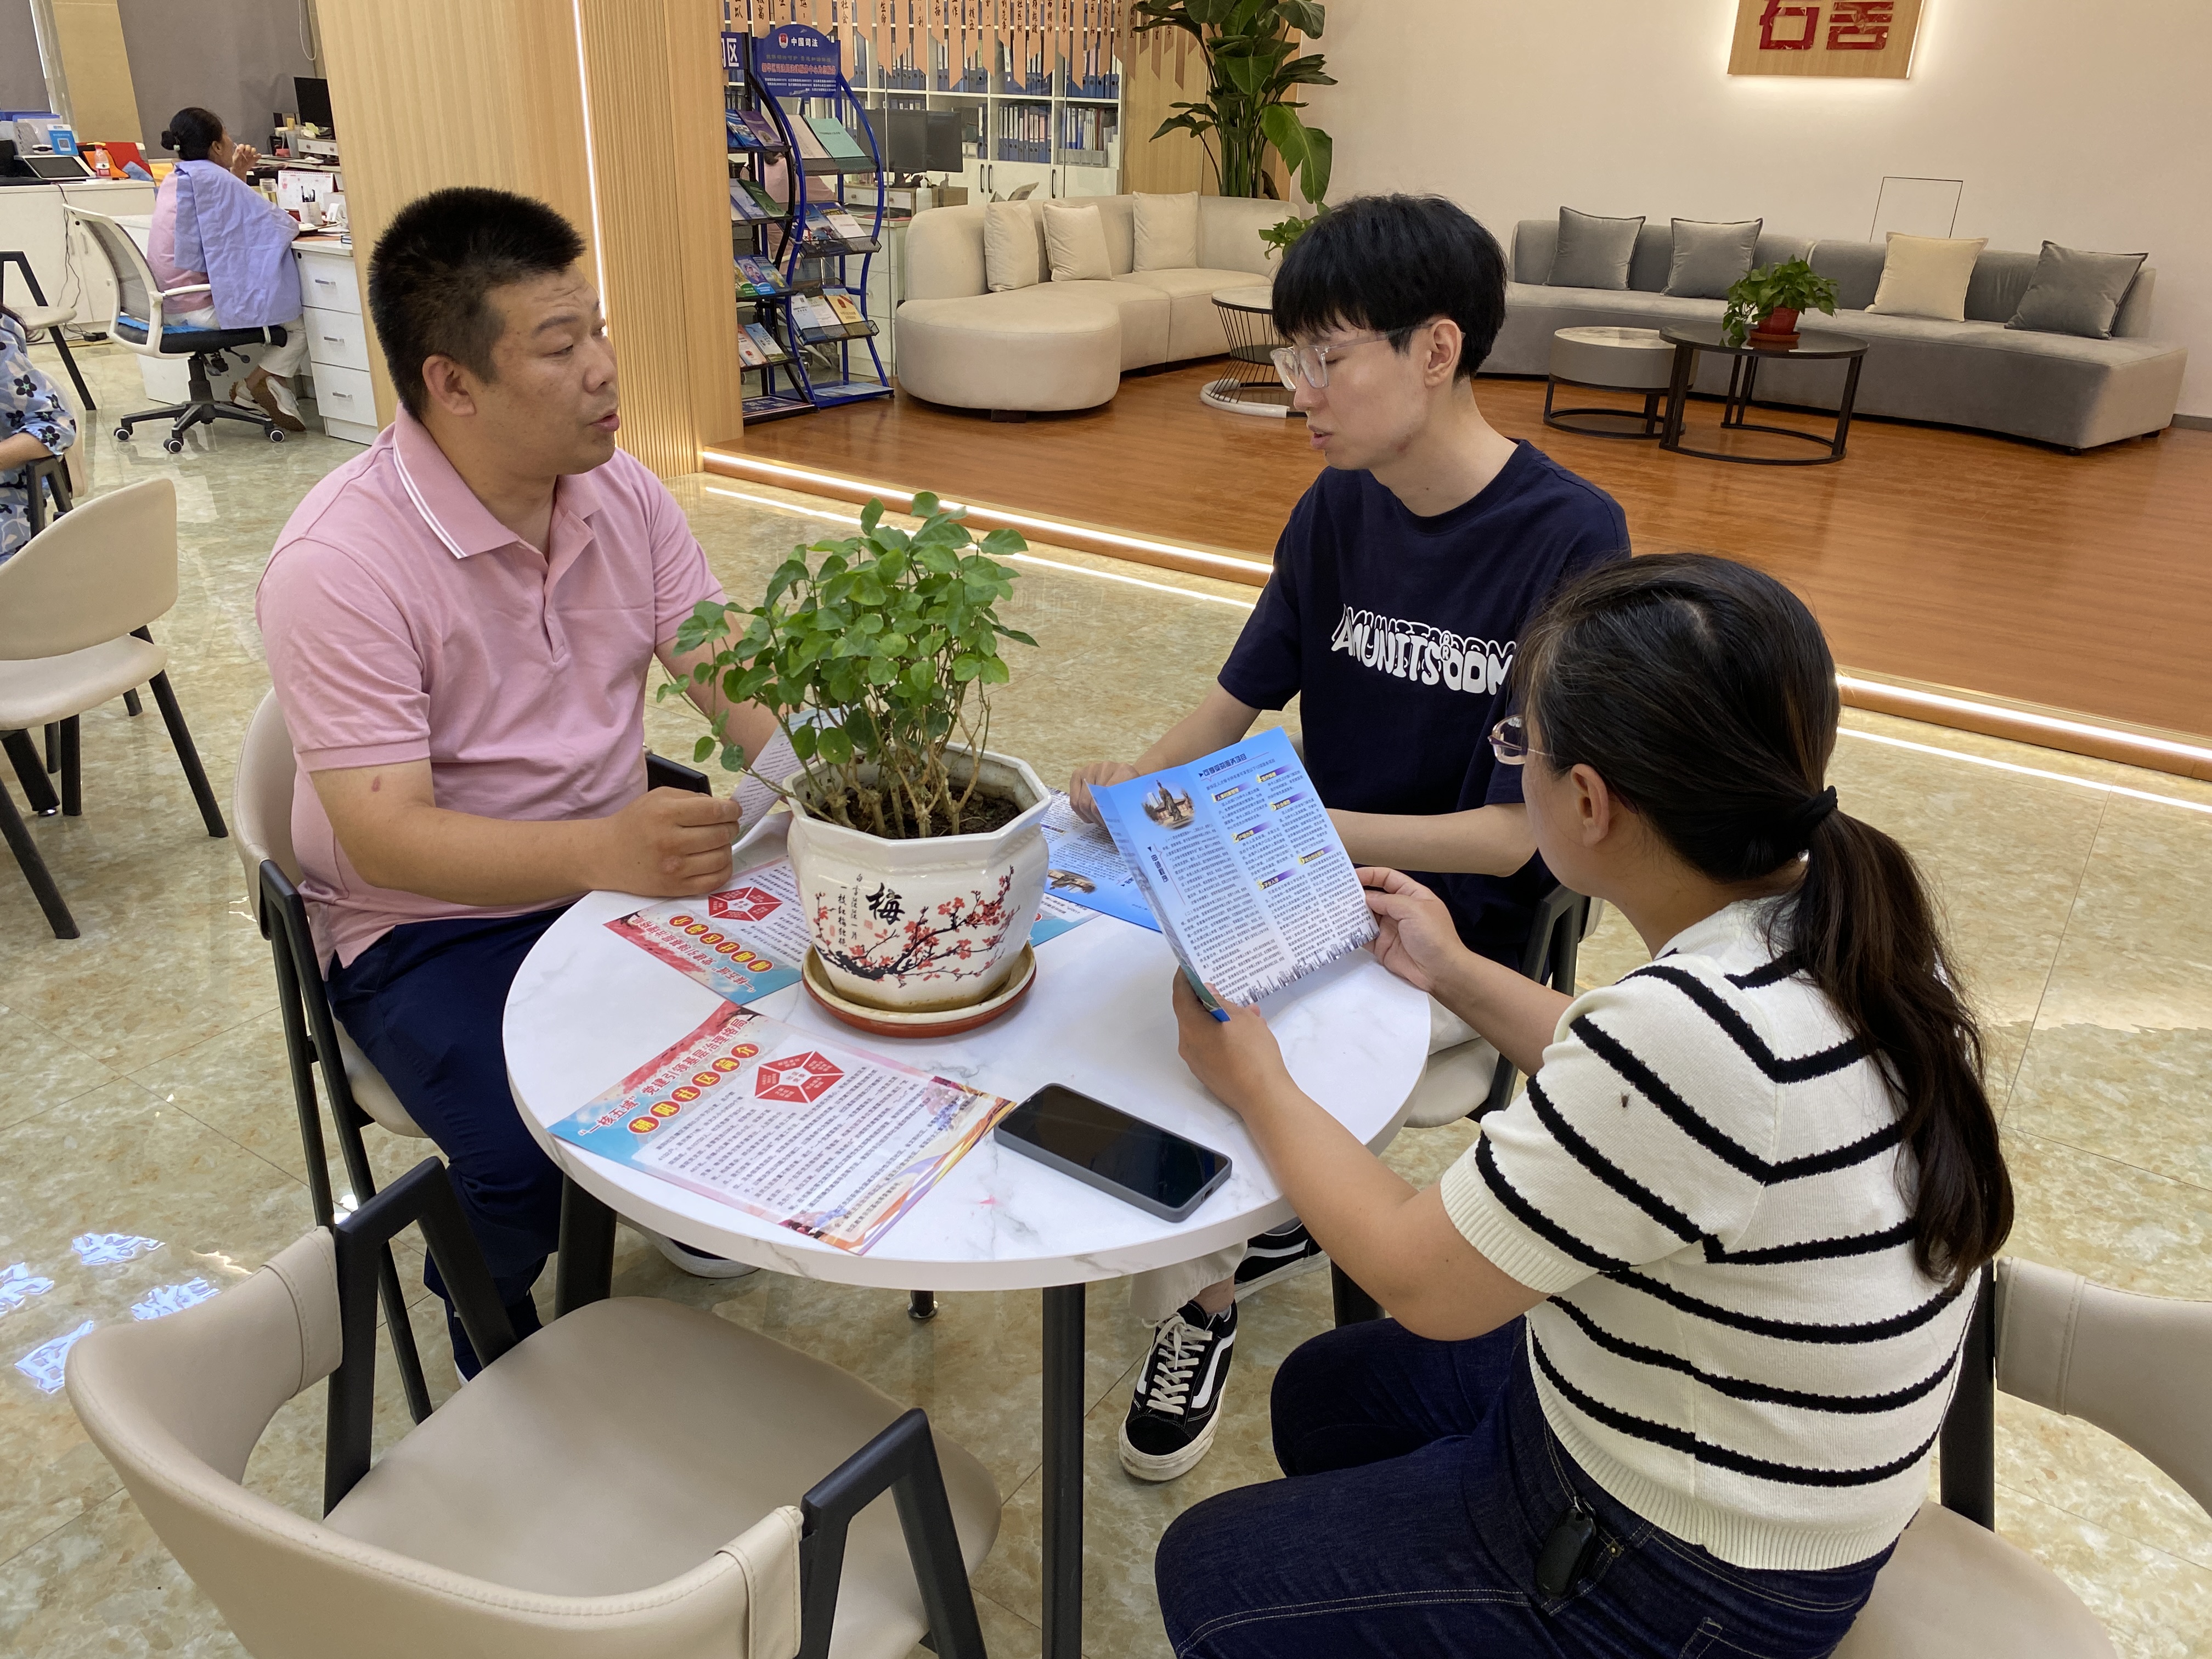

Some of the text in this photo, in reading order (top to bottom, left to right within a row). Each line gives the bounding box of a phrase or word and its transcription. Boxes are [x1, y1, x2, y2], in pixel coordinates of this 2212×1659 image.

[791, 37, 818, 47] 中国司法
[1202, 753, 1247, 776] 可享受的服务项目
[865, 882, 905, 925] 梅
[672, 917, 771, 973] 朝阳社区简介
[629, 1044, 758, 1132] 朝阳社区简介
